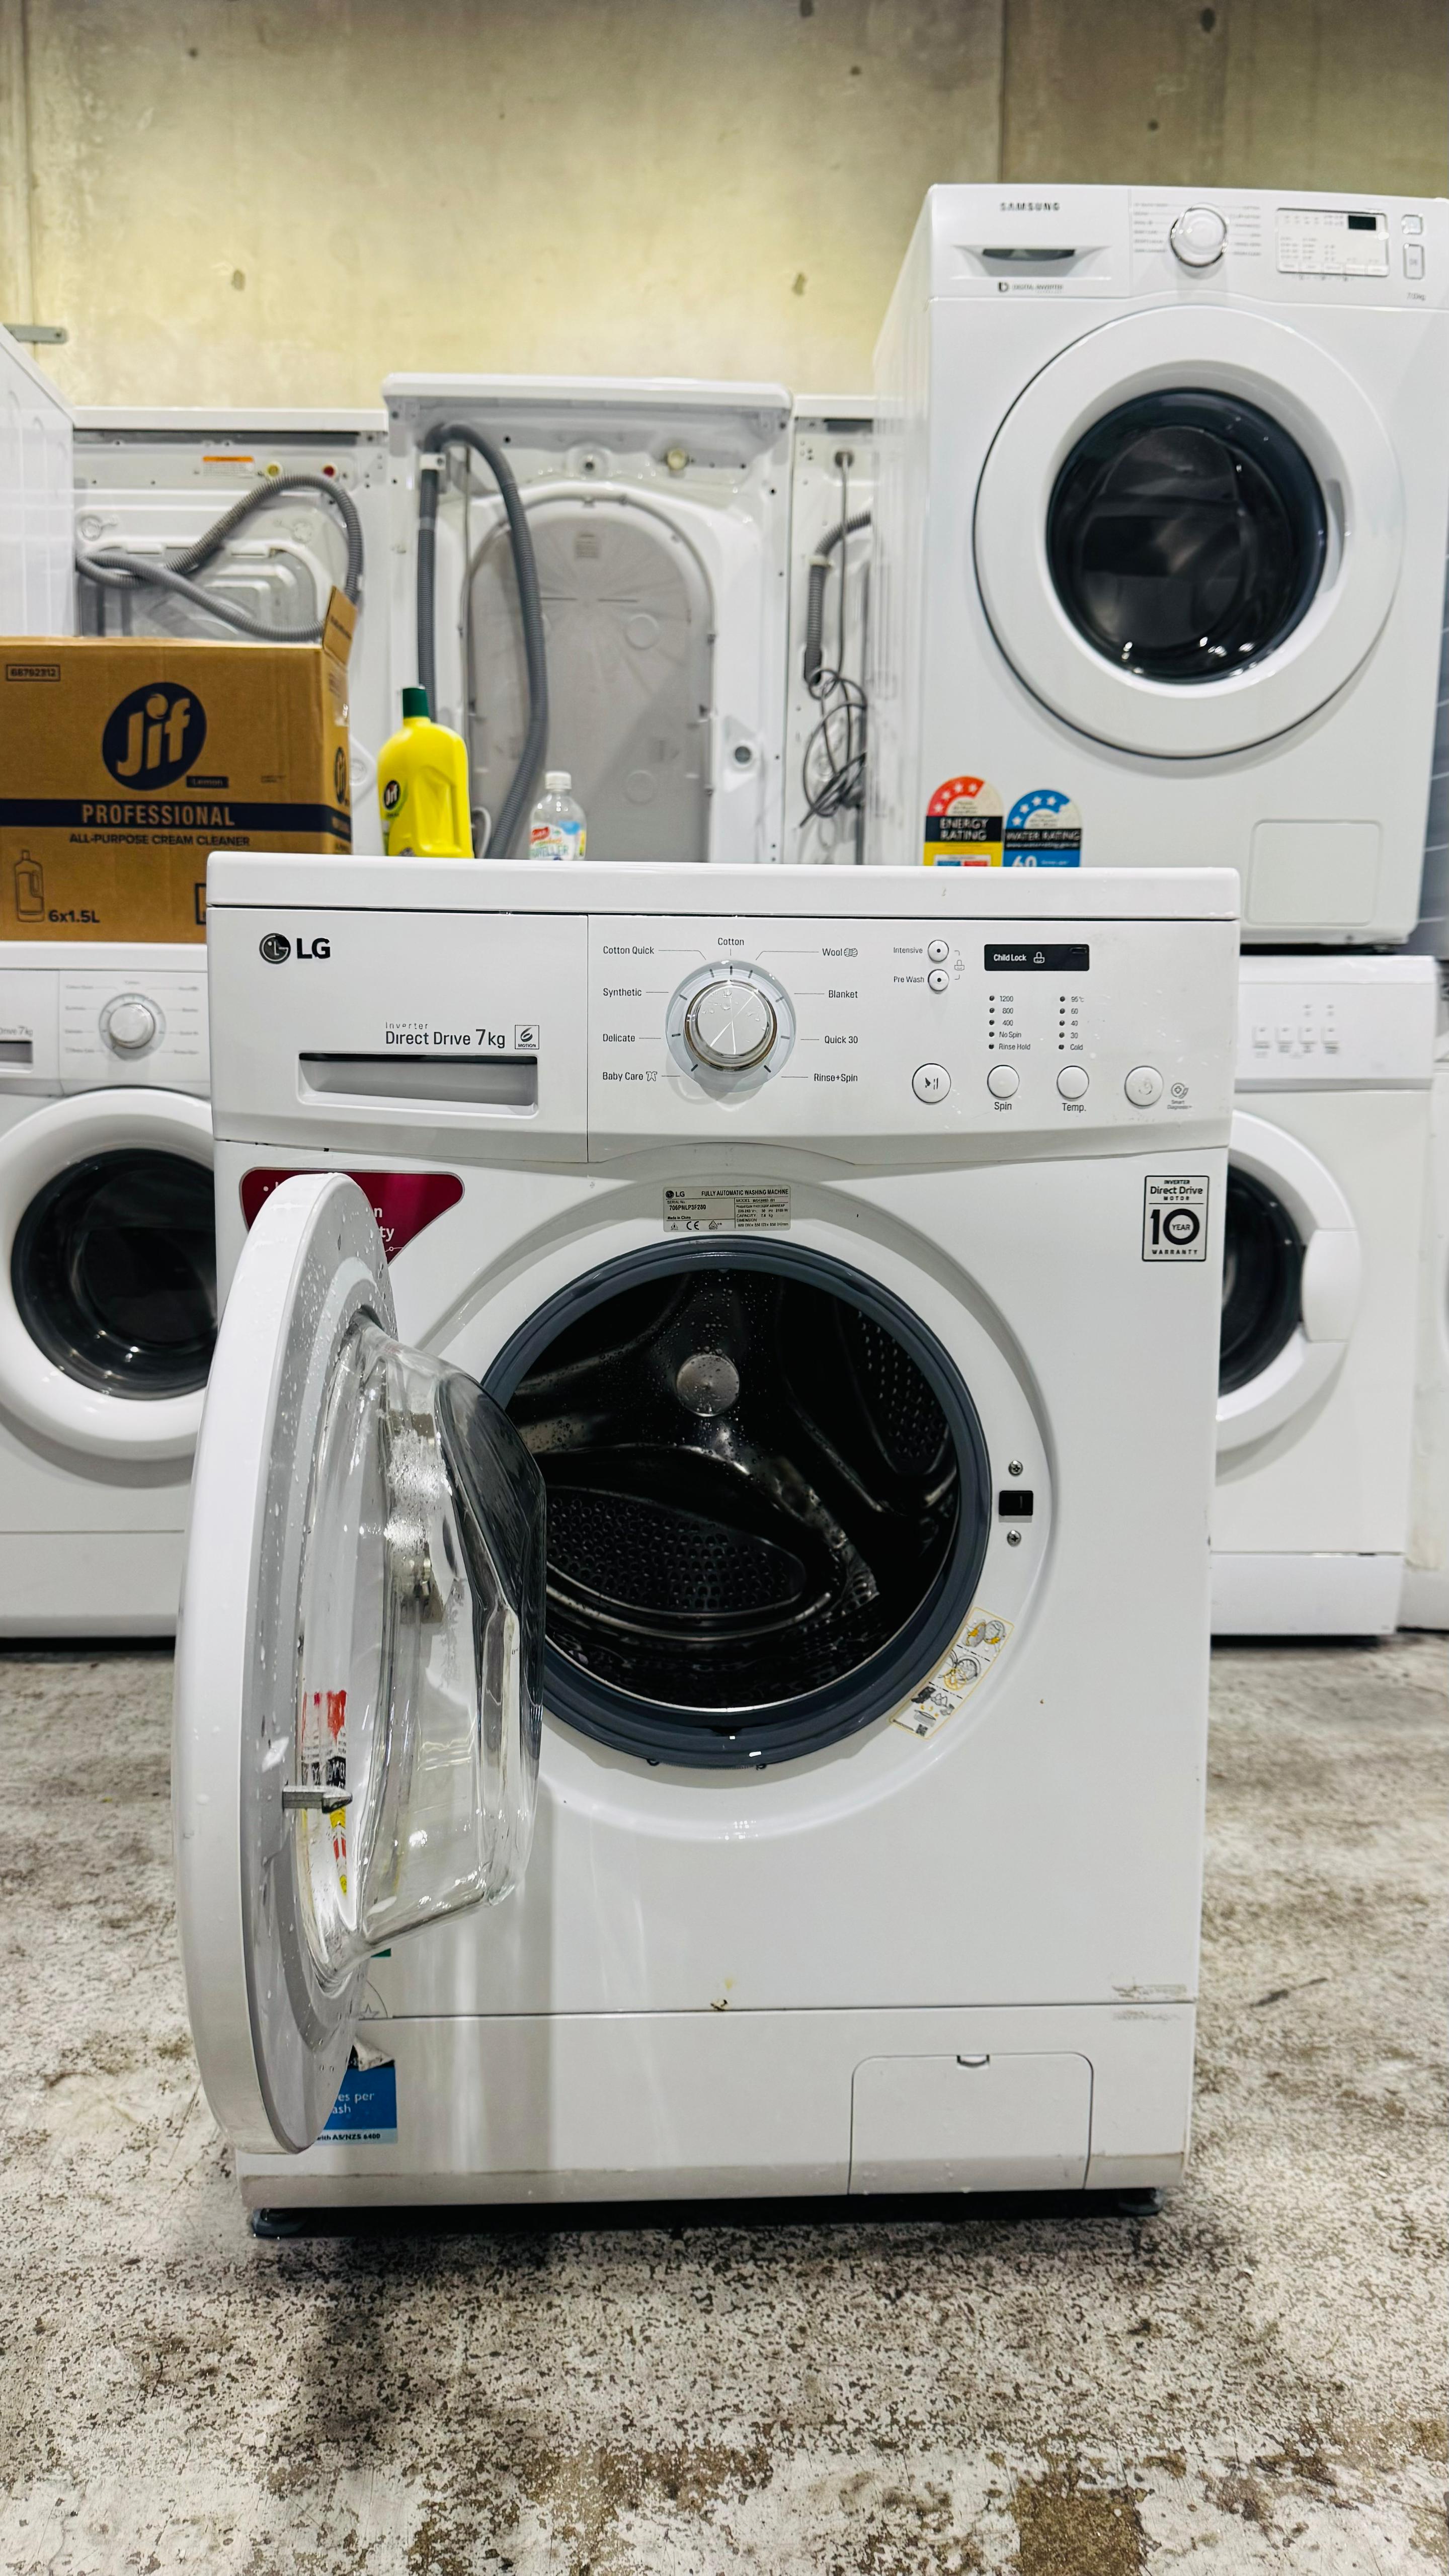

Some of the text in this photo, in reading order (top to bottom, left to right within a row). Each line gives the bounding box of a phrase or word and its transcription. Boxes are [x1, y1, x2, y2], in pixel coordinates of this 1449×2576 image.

[1000, 202, 1060, 211] SAMSUNG
[116, 693, 190, 777] Jif
[82, 804, 235, 827] PROFESSIONAL
[939, 818, 989, 829] ENERGY
[69, 834, 250, 846] ALL-PURPOSE CREAM CLEANER
[940, 829, 987, 841] RATING
[1006, 832, 1081, 841] WATER RATING
[48, 909, 100, 924] 6x1.5L
[717, 937, 745, 946] Cotton
[296, 938, 331, 959] LG
[603, 945, 655, 954] Cotton Quick
[822, 947, 843, 956] Wool
[993, 954, 1010, 962] Child
[603, 988, 642, 998] Synthetic
[828, 990, 858, 999] Blanket
[385, 1021, 428, 1029] Inverter
[385, 1031, 429, 1045] Direct
[433, 1031, 471, 1045] Drive
[602, 1033, 635, 1042] Delicate
[824, 1035, 858, 1044] Quick 30
[1009, 1031, 1022, 1039] Spin
[602, 1072, 643, 1082] Baby Care
[813, 1073, 858, 1083] Rinse+Spin
[994, 1101, 1012, 1111] Spin
[1062, 1102, 1086, 1113] Temp.
[1150, 1186, 1203, 1194] Direct Drive
[686, 1221, 700, 1230] CE
[1150, 1208, 1200, 1246] 10
[354, 2092, 374, 2104] per
[332, 2103, 351, 2114] ash
